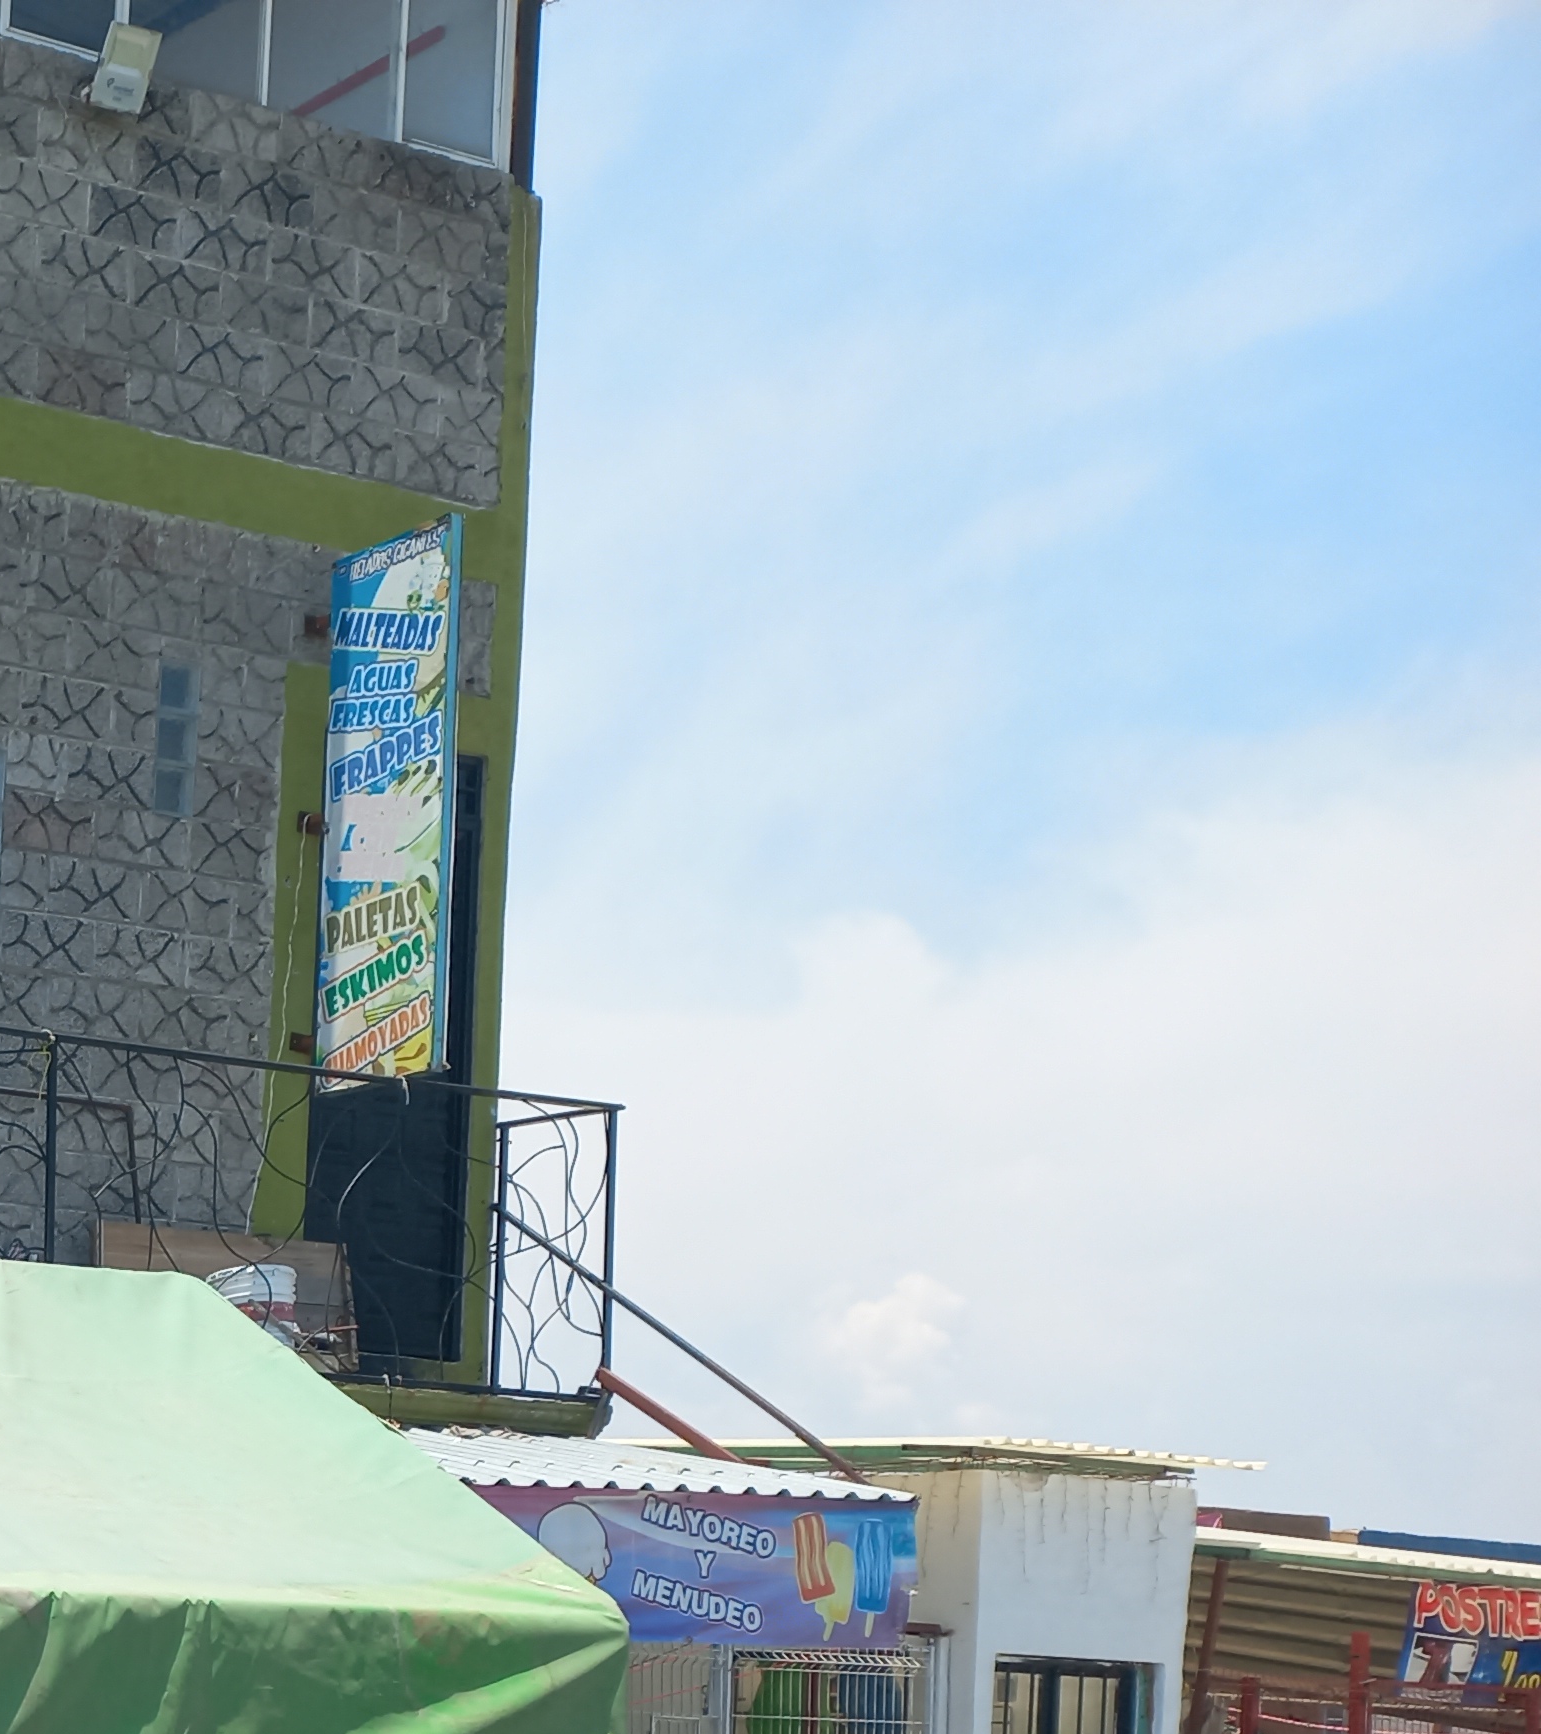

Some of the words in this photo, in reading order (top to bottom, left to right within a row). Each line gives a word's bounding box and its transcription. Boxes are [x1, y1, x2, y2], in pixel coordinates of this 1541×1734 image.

[335, 610, 444, 653] MALTEADAS
[350, 660, 416, 695] AGUAS
[331, 698, 415, 731] FRESCAS
[332, 713, 442, 798] FRAPPES
[326, 885, 419, 954] PALETAS
[324, 933, 425, 1018] ESKIMOS
[641, 1494, 777, 1559] MAYOREO
[694, 1549, 717, 1579] Y
[631, 1569, 764, 1633] MENUDEO
